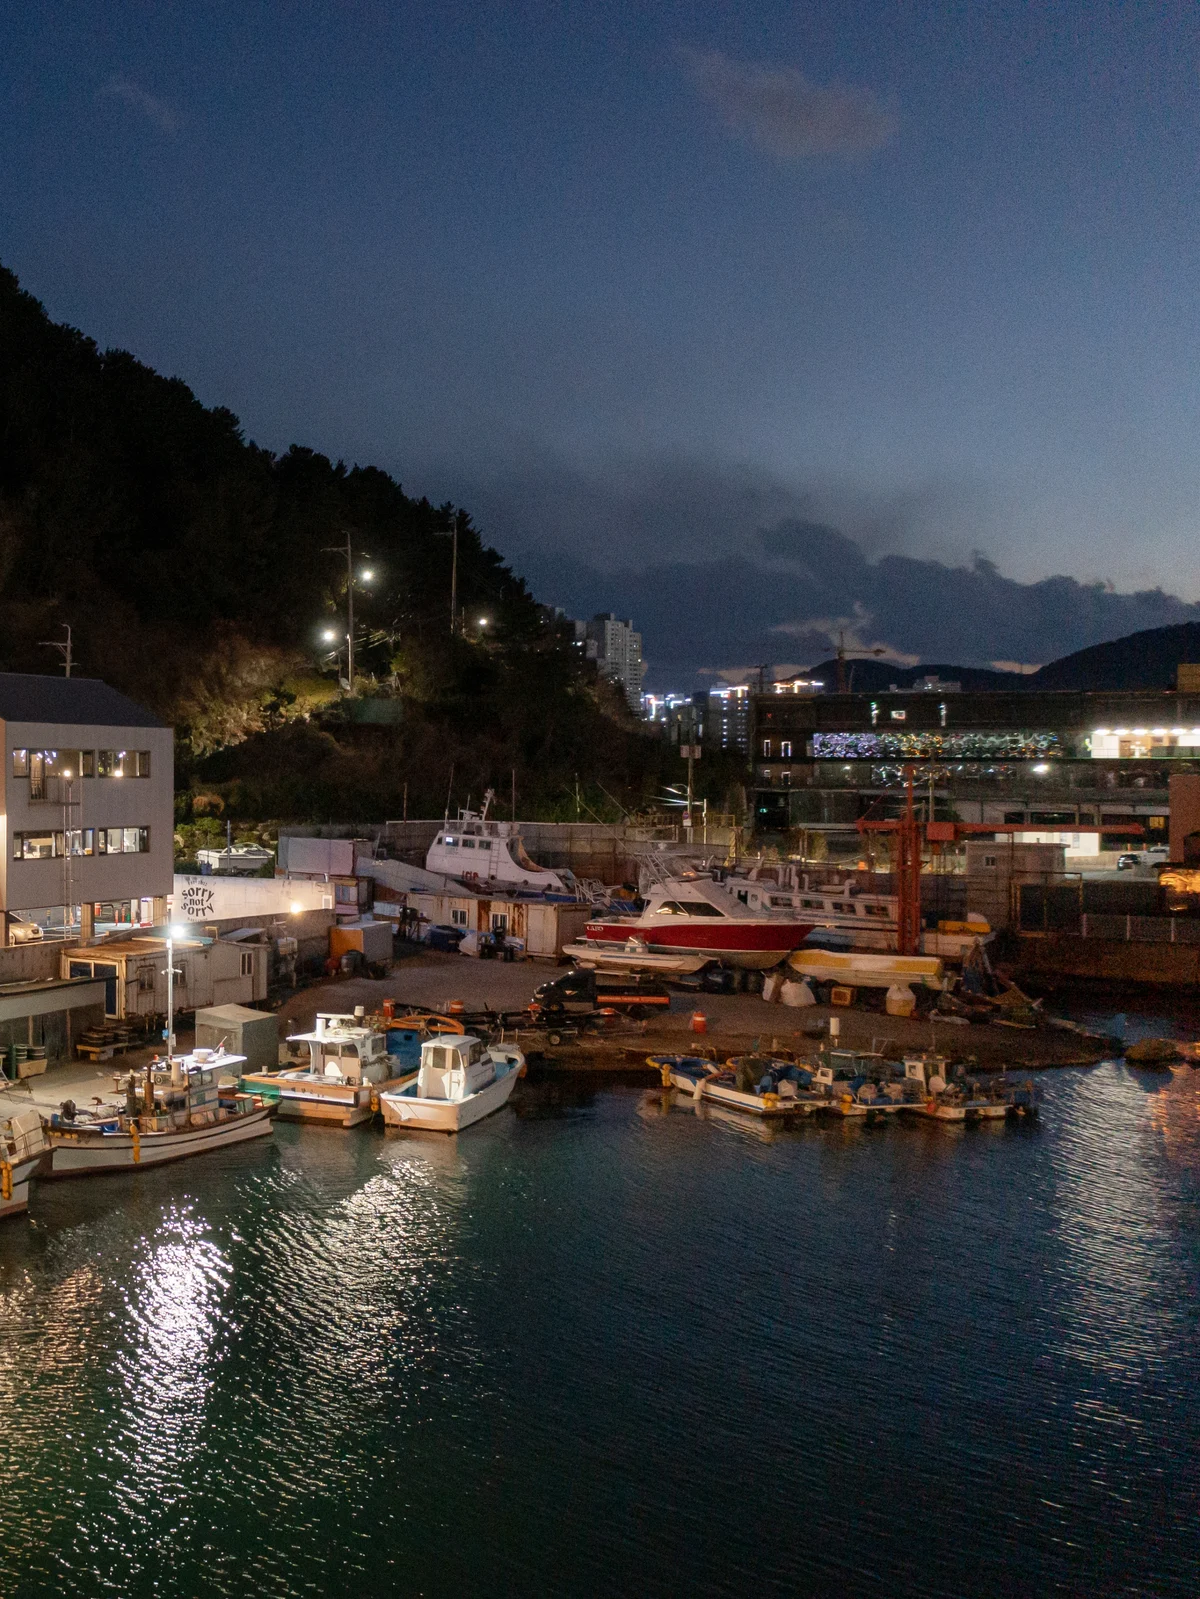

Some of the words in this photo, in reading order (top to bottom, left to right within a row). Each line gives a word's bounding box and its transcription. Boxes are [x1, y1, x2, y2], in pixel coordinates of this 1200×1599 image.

[181, 887, 215, 903] sorry
[189, 898, 205, 907] not
[181, 902, 215, 917] sorry
